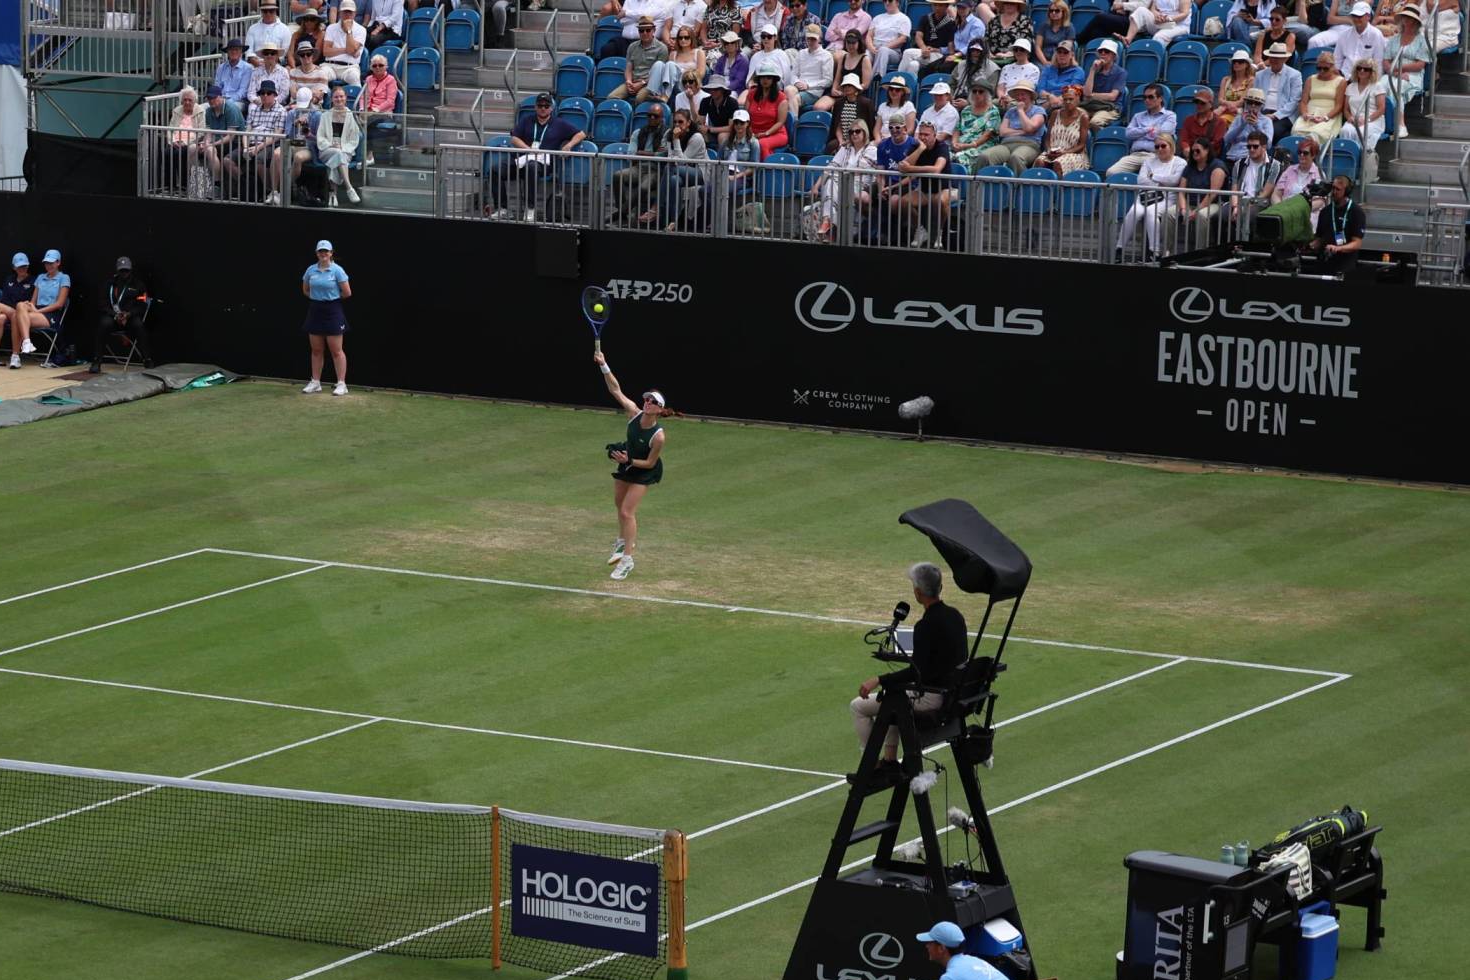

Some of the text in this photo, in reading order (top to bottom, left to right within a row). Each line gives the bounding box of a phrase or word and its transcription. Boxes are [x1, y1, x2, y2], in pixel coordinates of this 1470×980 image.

[863, 297, 1044, 336] LEXUS
[1219, 298, 1351, 327] LEXUS
[1157, 331, 1361, 399] EASTBOURNE
[812, 390, 891, 404] CREW CLOTHING
[828, 400, 874, 411] COMPANY
[1225, 398, 1287, 436] OPEN
[522, 868, 647, 912] HOLOGIC
[568, 908, 641, 927] The Science of Sure
[1187, 907, 1195, 923] LTA
[1186, 925, 1194, 939] the
[1186, 940, 1193, 950] of
